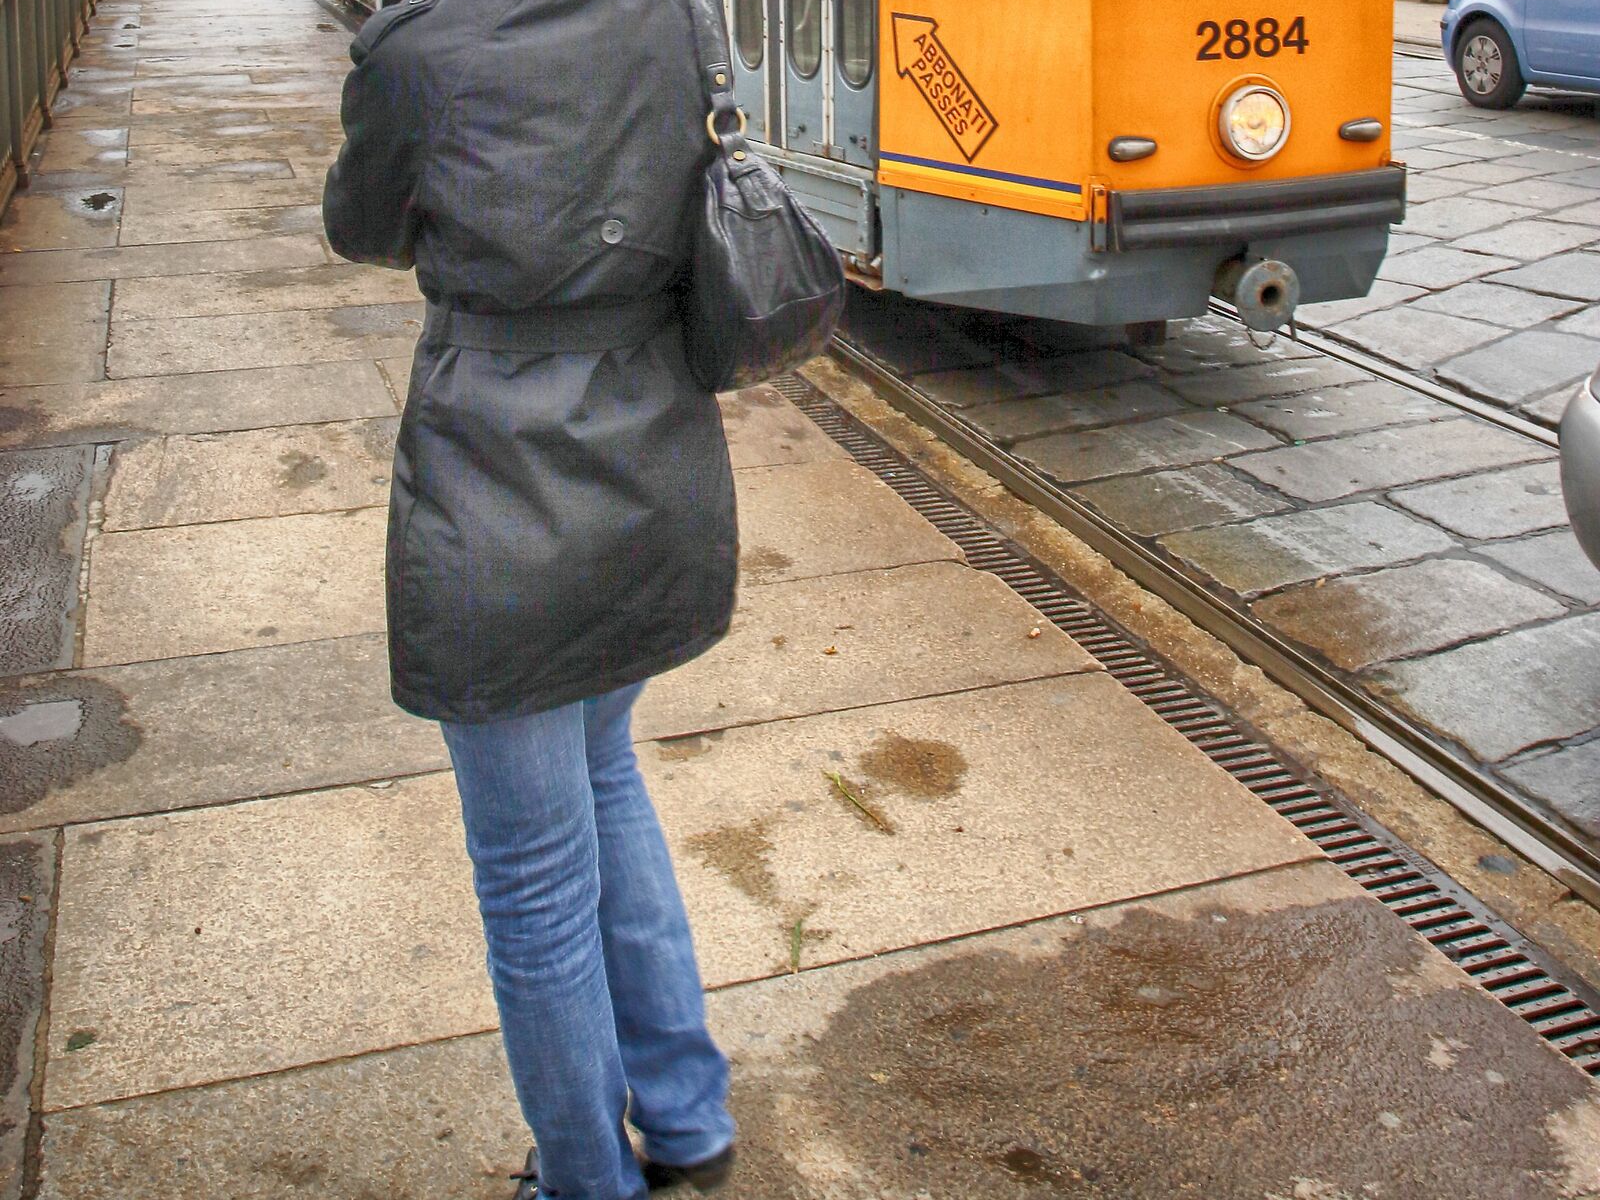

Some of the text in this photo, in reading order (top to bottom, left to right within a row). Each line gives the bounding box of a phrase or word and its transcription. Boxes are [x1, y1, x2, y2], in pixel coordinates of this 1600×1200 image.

[1196, 16, 1309, 61] 2884
[911, 58, 969, 136] PASSES
[913, 33, 988, 134] ABBONATI
